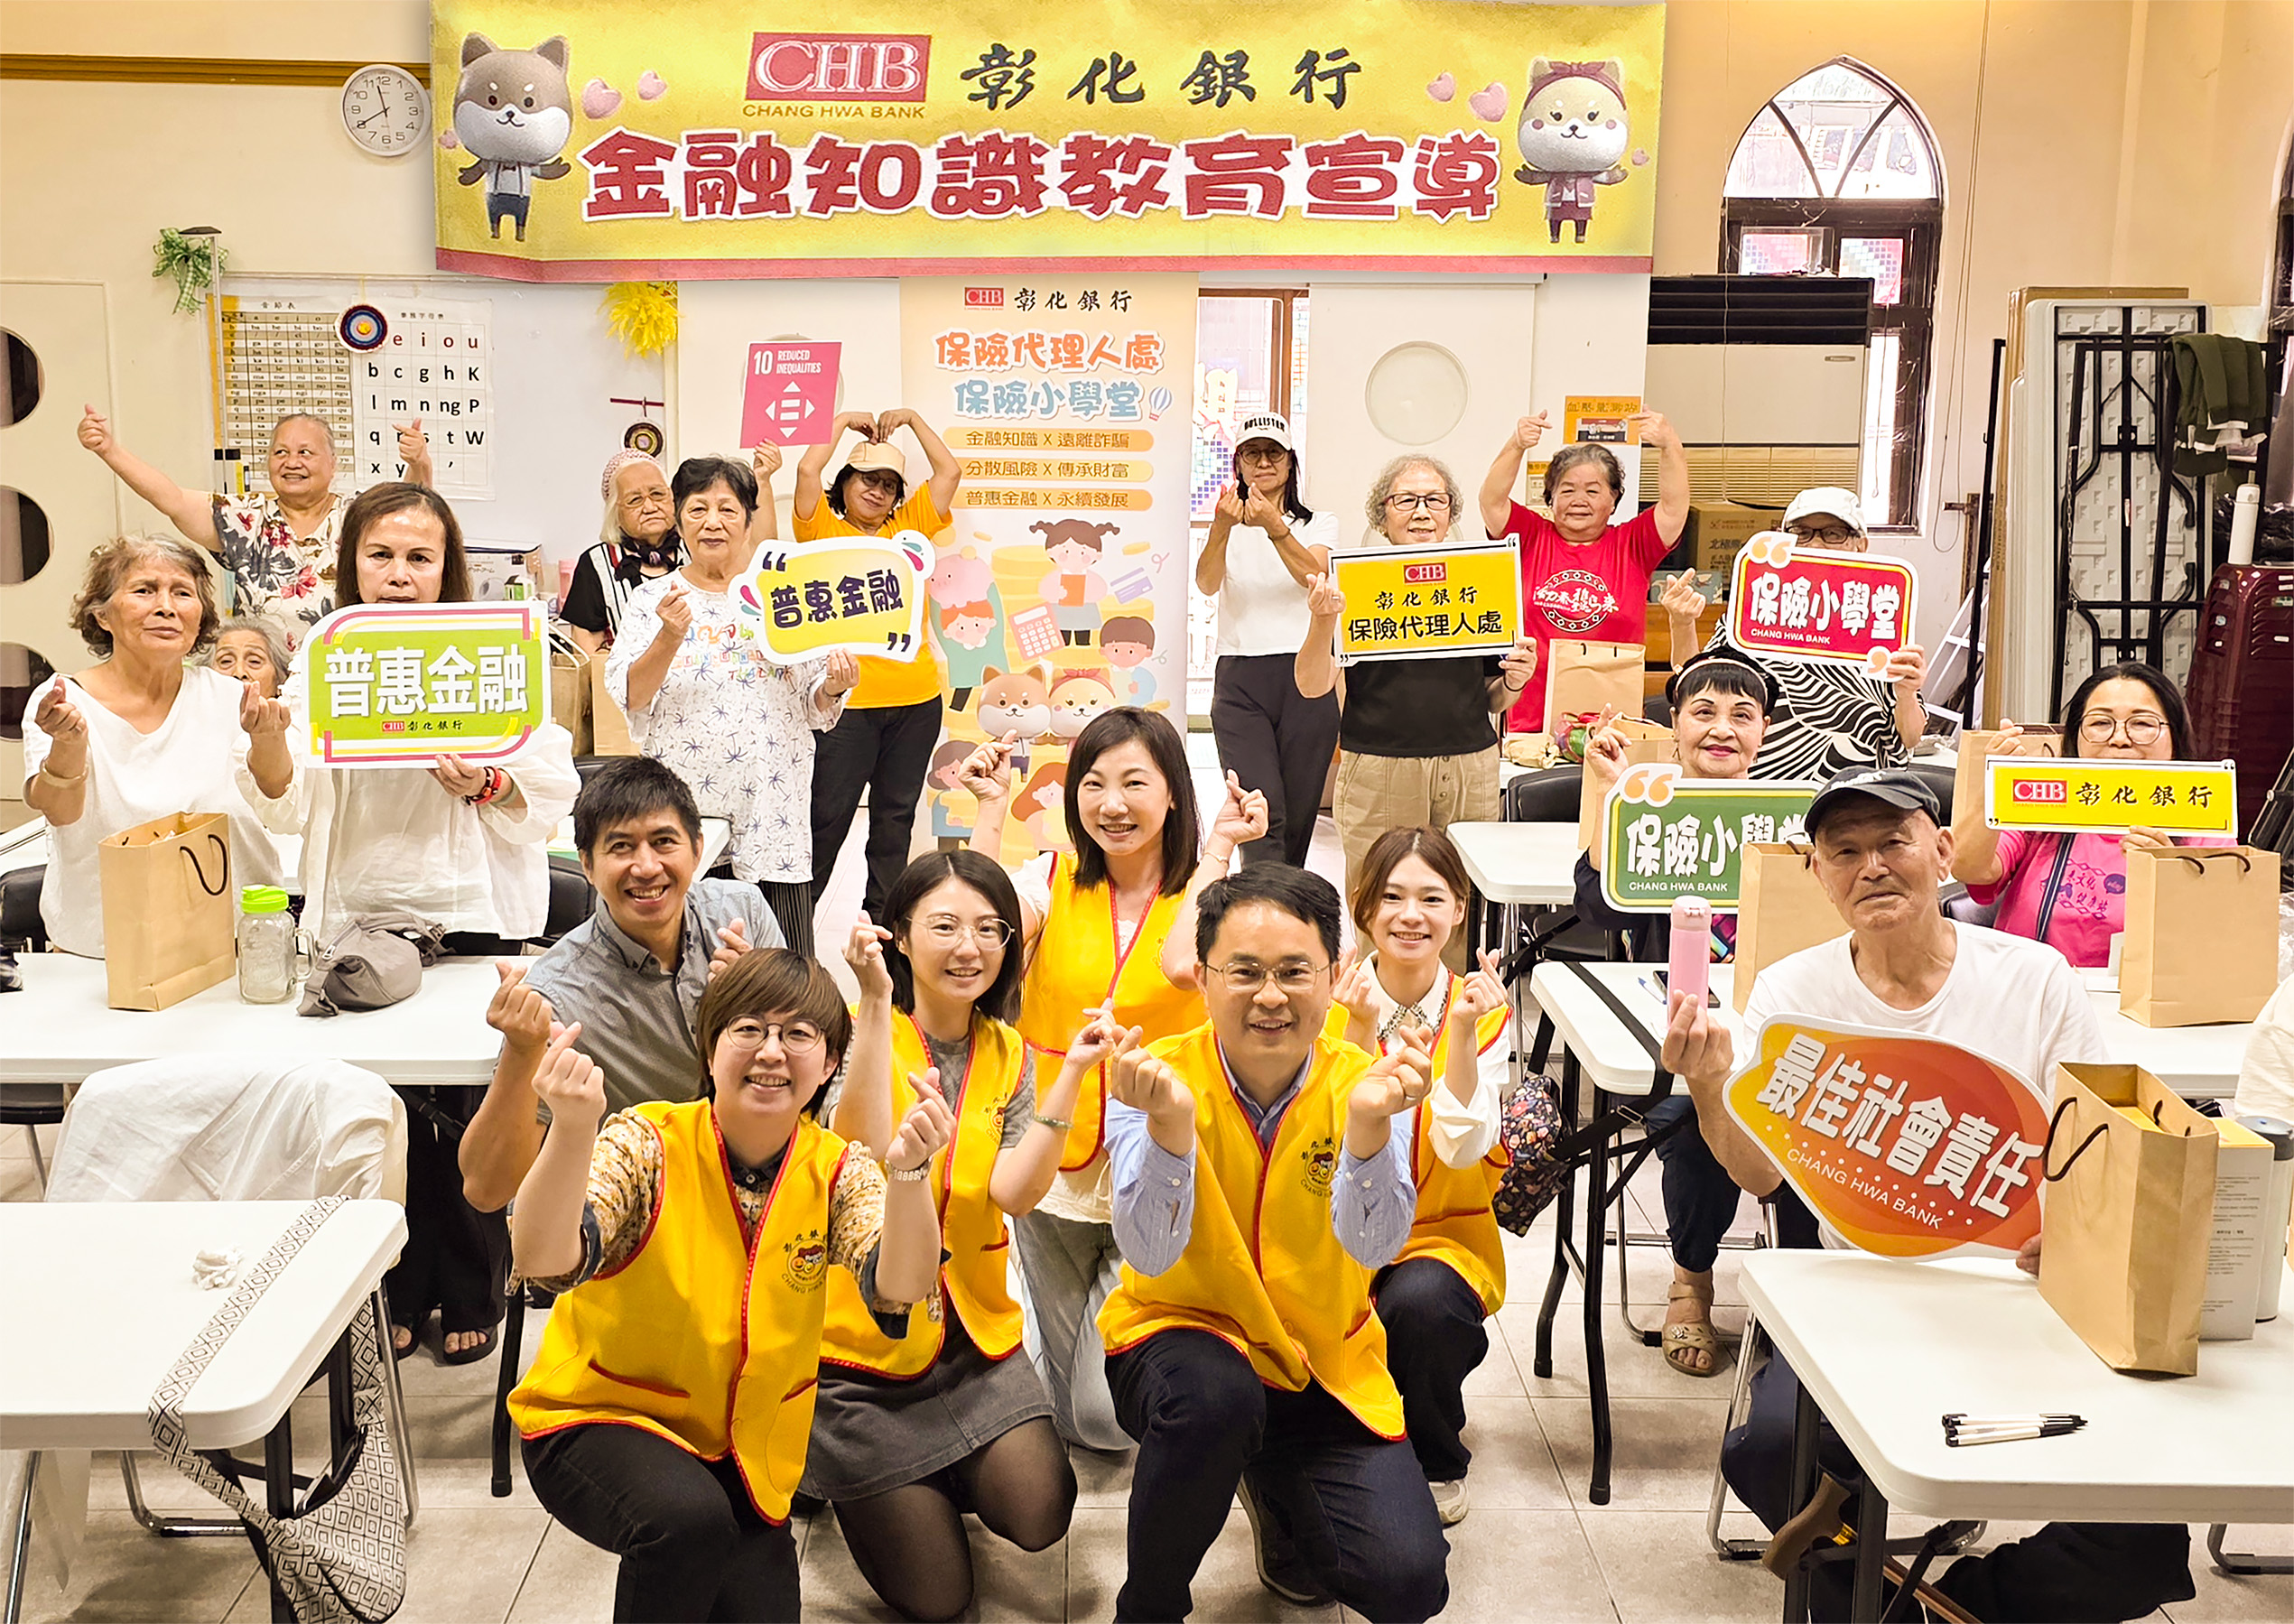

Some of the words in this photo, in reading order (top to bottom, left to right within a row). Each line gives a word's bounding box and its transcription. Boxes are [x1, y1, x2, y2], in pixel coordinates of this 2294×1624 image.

[754, 40, 922, 94] CHB
[376, 76, 391, 86] 12
[961, 44, 1361, 110] 彰化銀行
[353, 90, 368, 100] 10
[404, 91, 414, 101] 2
[351, 105, 361, 115] 9
[408, 107, 418, 116] 3
[743, 104, 814, 118] CHANG
[820, 105, 865, 118] HWA
[871, 106, 924, 119] BANK
[405, 121, 414, 130] 4
[367, 131, 377, 140] 7
[381, 135, 391, 144] 6
[395, 131, 405, 141] 5
[583, 131, 1500, 222] 金融知識教育宣導
[965, 289, 1002, 305] CHB
[1014, 288, 1132, 312] 彰化銀行
[392, 333, 404, 347] e
[421, 332, 426, 348] i
[442, 336, 454, 348] o
[468, 336, 478, 348] u
[777, 349, 811, 361] REDUCED
[935, 332, 1160, 369] 保險代理人處
[754, 350, 773, 375] 10
[776, 362, 822, 375] INEQUALITIES
[367, 362, 379, 377] b
[394, 367, 404, 378] c
[419, 367, 430, 383] g
[444, 365, 454, 381] h
[954, 379, 1141, 418] 保險小學堂
[391, 399, 407, 411] m
[419, 399, 430, 412] n
[439, 400, 461, 416] ng
[369, 430, 380, 446] q
[447, 431, 454, 444] t
[966, 431, 1037, 447] 金融知識
[1057, 432, 1129, 449] 遠離詐騙
[371, 461, 381, 474] x
[395, 462, 405, 478] y
[966, 460, 1037, 477] 分散風險
[1057, 462, 1128, 478] 傳承財富
[965, 490, 1037, 506] 普惠金融
[1057, 492, 1128, 508] 永續發展
[1406, 564, 1444, 581] CHB
[770, 569, 904, 628] 普惠金融
[1374, 586, 1479, 610] 彰化銀行
[1750, 571, 1900, 640] 保險小學堂
[1348, 611, 1502, 642] 保險代理人處
[1751, 628, 1782, 639] CHANG
[1784, 631, 1805, 642] HWA
[1806, 634, 1831, 645] BANK
[324, 645, 528, 718] 普惠金融
[383, 722, 404, 731] CHB
[408, 719, 462, 731] 彰化銀行
[2014, 782, 2066, 801] CHB
[2076, 782, 2213, 808] 彰化銀行
[1629, 881, 1667, 892] CHANG
[1670, 882, 1695, 892] HWA
[1697, 882, 1728, 892] BANK
[1756, 1033, 2044, 1218] 最佳社會責任
[1787, 1148, 1846, 1184] CHANG
[1850, 1178, 1889, 1206] HWA
[1892, 1199, 1943, 1230] BANK
[781, 1273, 806, 1294] CHANG
